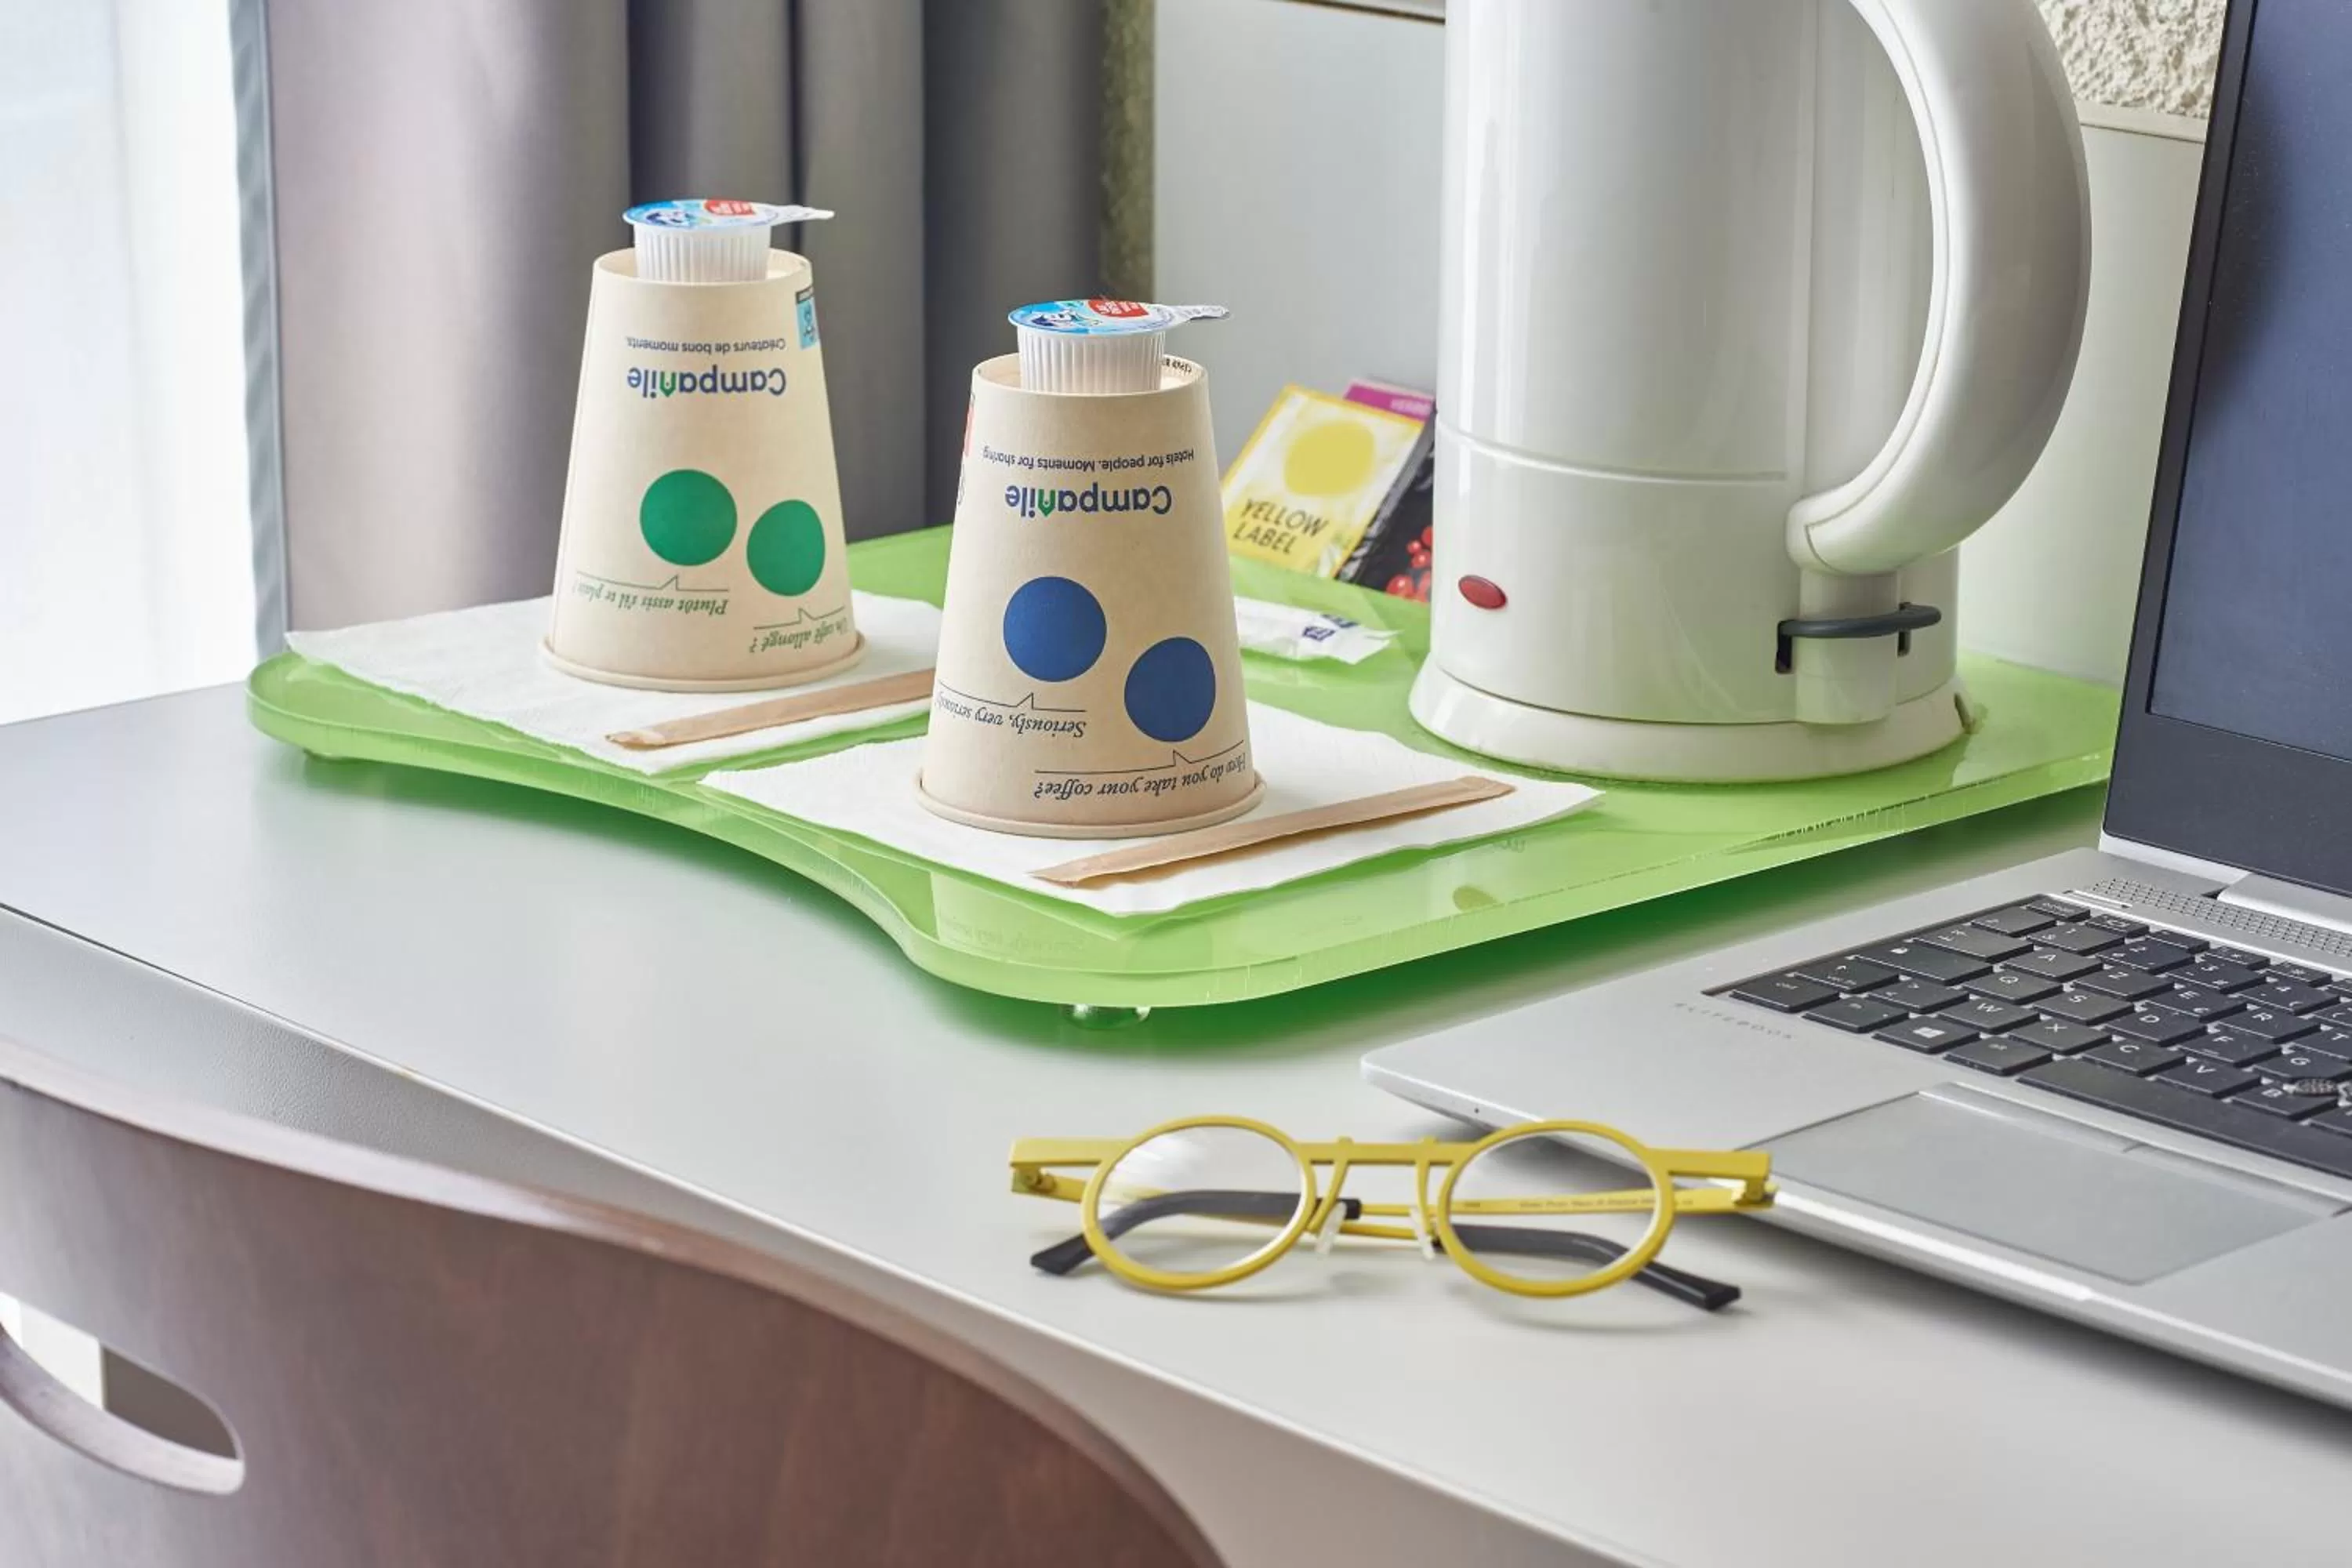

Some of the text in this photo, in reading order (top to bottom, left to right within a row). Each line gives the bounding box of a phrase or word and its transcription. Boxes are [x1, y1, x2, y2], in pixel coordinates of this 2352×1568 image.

[682, 341, 712, 354] bons
[715, 343, 731, 354] de
[734, 338, 786, 353] Créateurs
[627, 364, 787, 398] Campanile
[1017, 456, 1034, 470] for
[1037, 456, 1096, 471] Moments
[1098, 455, 1145, 472] people.
[1147, 455, 1164, 468] for
[1167, 448, 1195, 465] Hotels
[1004, 481, 1173, 518] Campanile
[1240, 498, 1330, 539] YELLOW
[1232, 522, 1299, 555] LABEL
[677, 599, 730, 615] Plutôt
[975, 706, 1004, 725] very
[1009, 713, 1087, 738] Seriously,
[1033, 753, 1247, 800] How do you take your coffee?
